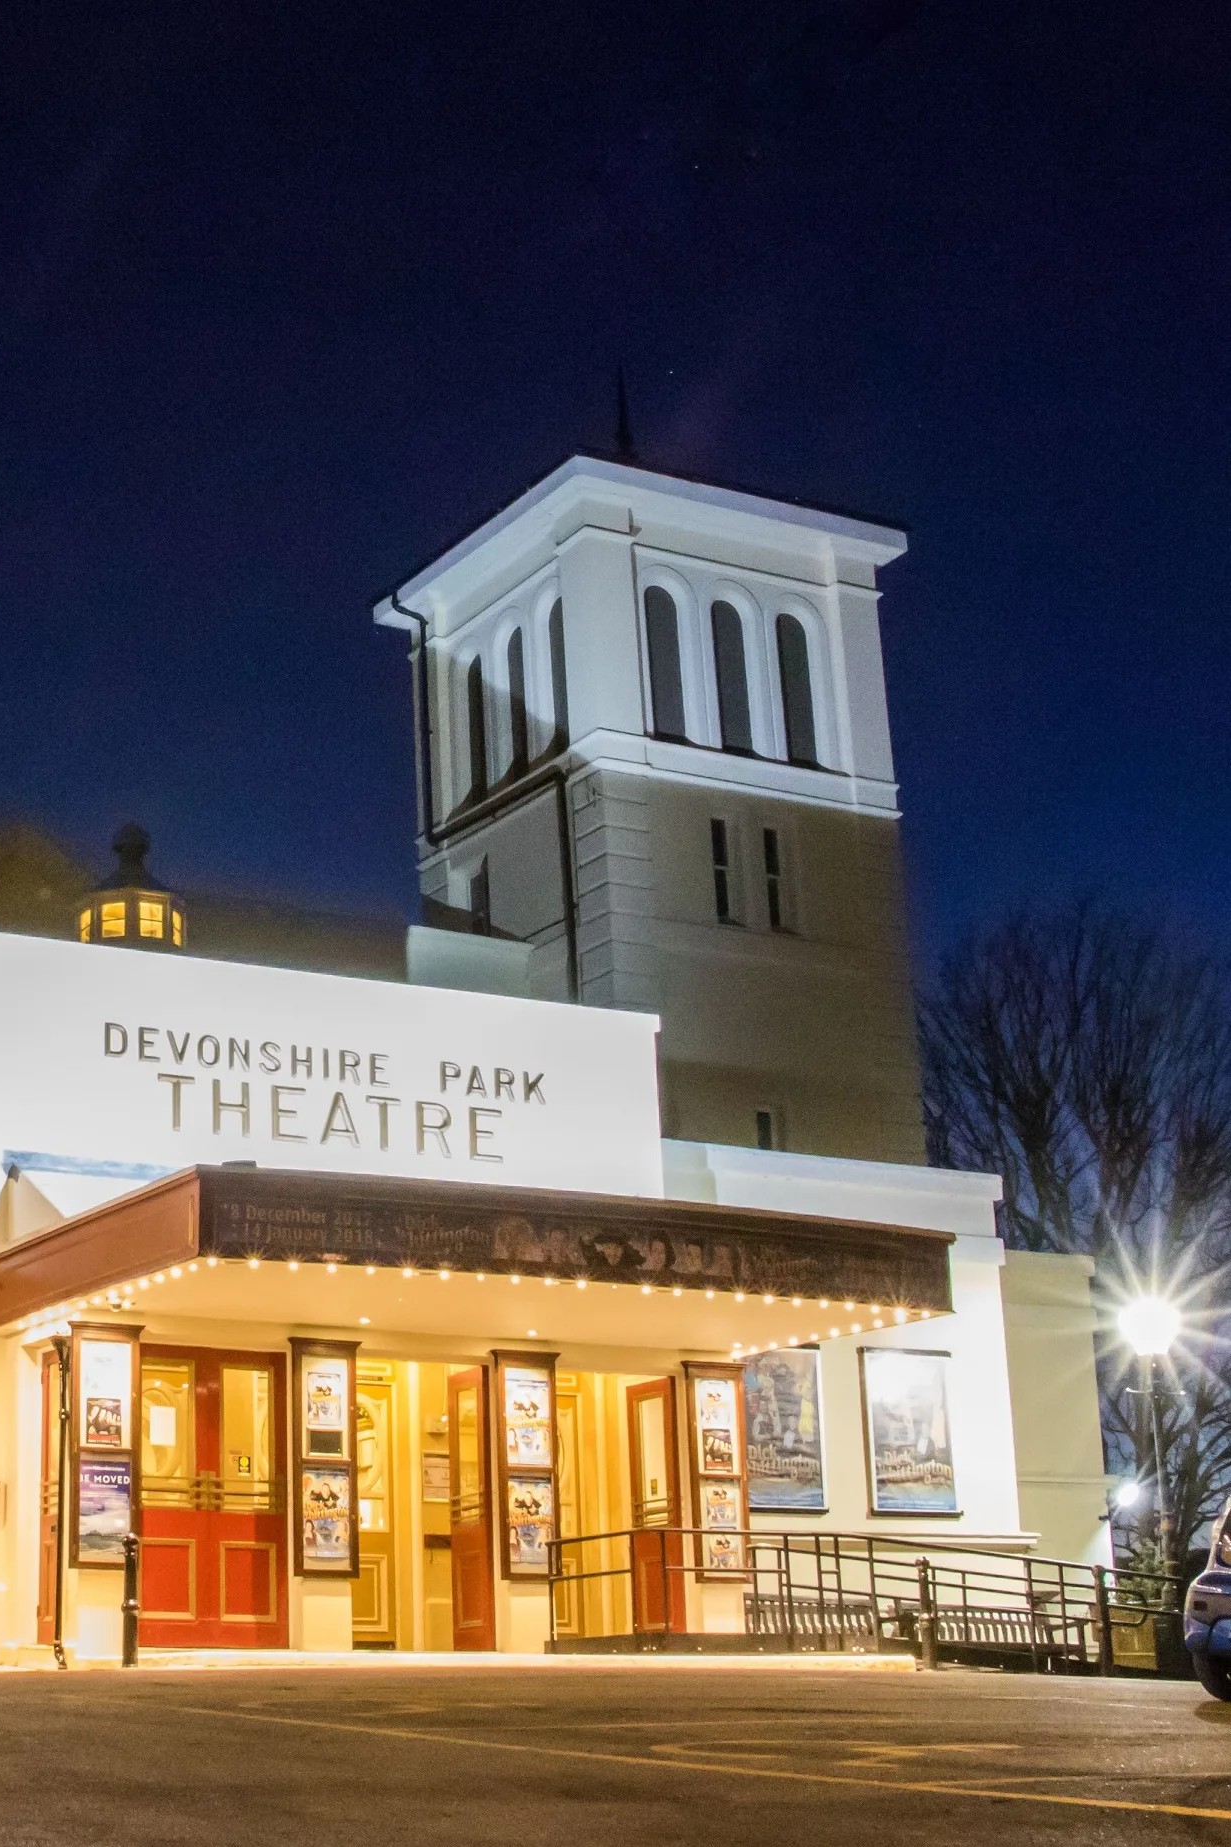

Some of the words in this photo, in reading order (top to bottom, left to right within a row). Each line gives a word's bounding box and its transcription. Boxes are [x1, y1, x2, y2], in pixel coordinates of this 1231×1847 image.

[104, 1021, 391, 1087] DEVONSHIRE
[439, 1060, 546, 1105] PARK
[157, 1072, 504, 1164] THEATRE
[245, 1203, 327, 1225] December
[334, 1228, 373, 1245] 2018
[94, 1475, 130, 1485] MOVED
